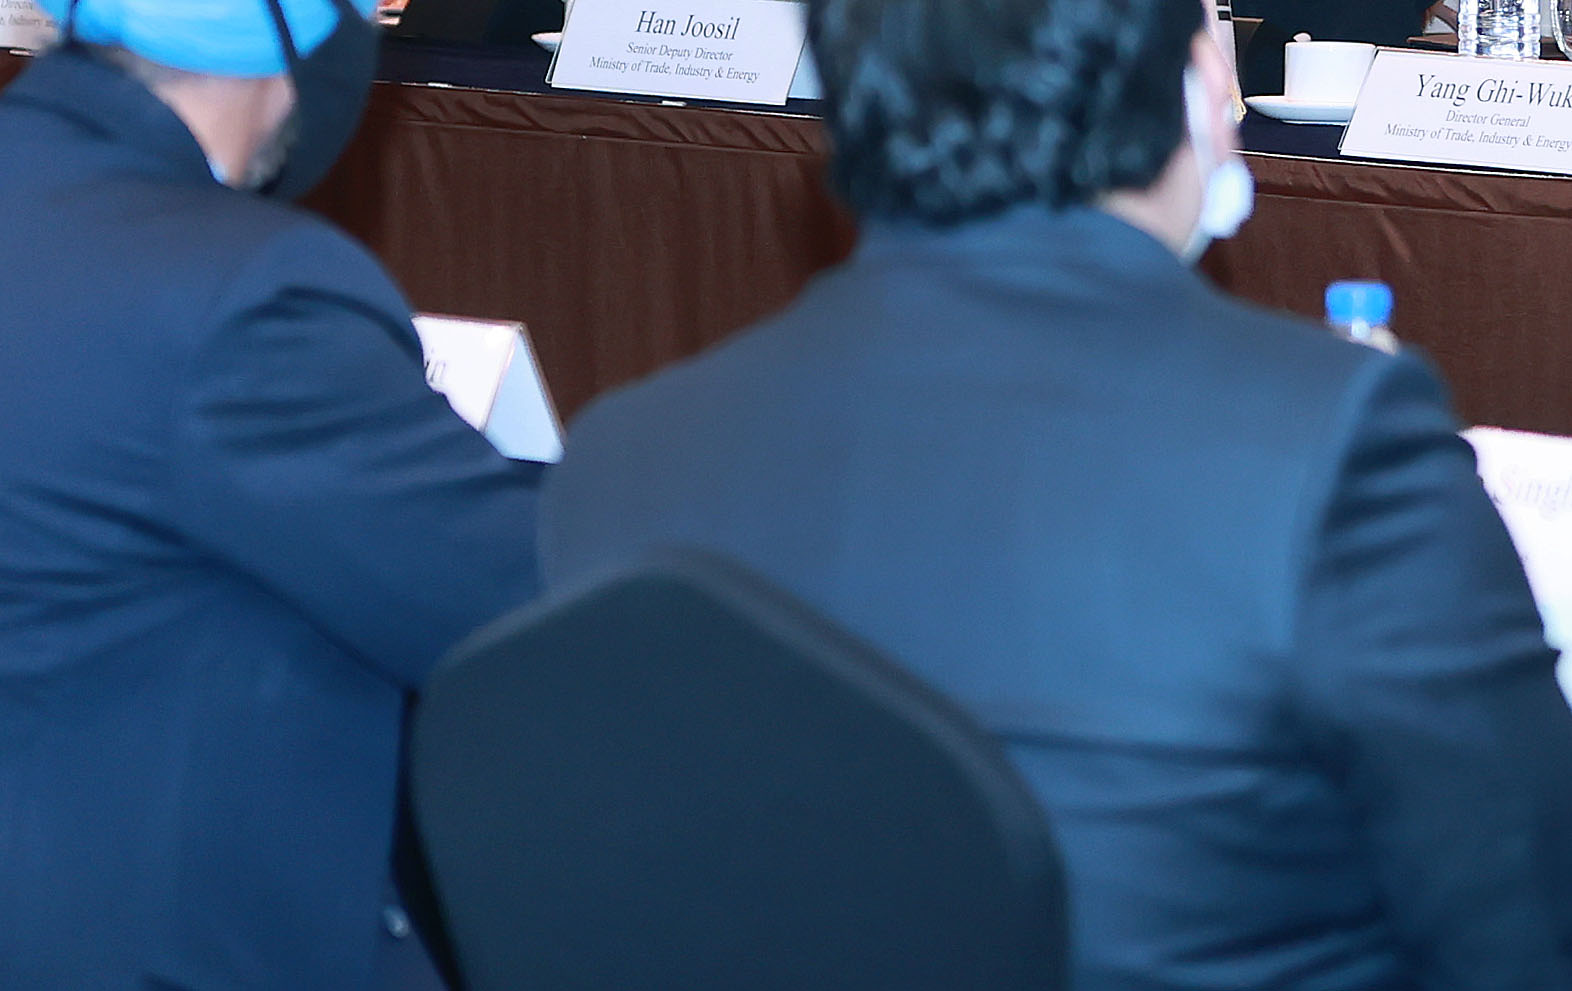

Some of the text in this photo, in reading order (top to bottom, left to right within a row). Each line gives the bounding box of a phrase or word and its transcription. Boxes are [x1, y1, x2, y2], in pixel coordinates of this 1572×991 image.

[635, 10, 740, 40] Han Joosil
[626, 42, 733, 61] Senior Deputy Director
[589, 56, 760, 83] Ministry of Trade, Industry & Energy
[1416, 74, 1471, 106] Yang
[1445, 110, 1531, 128] Director General
[1384, 123, 1572, 152] Ministry of Trade, Industry & Energy
